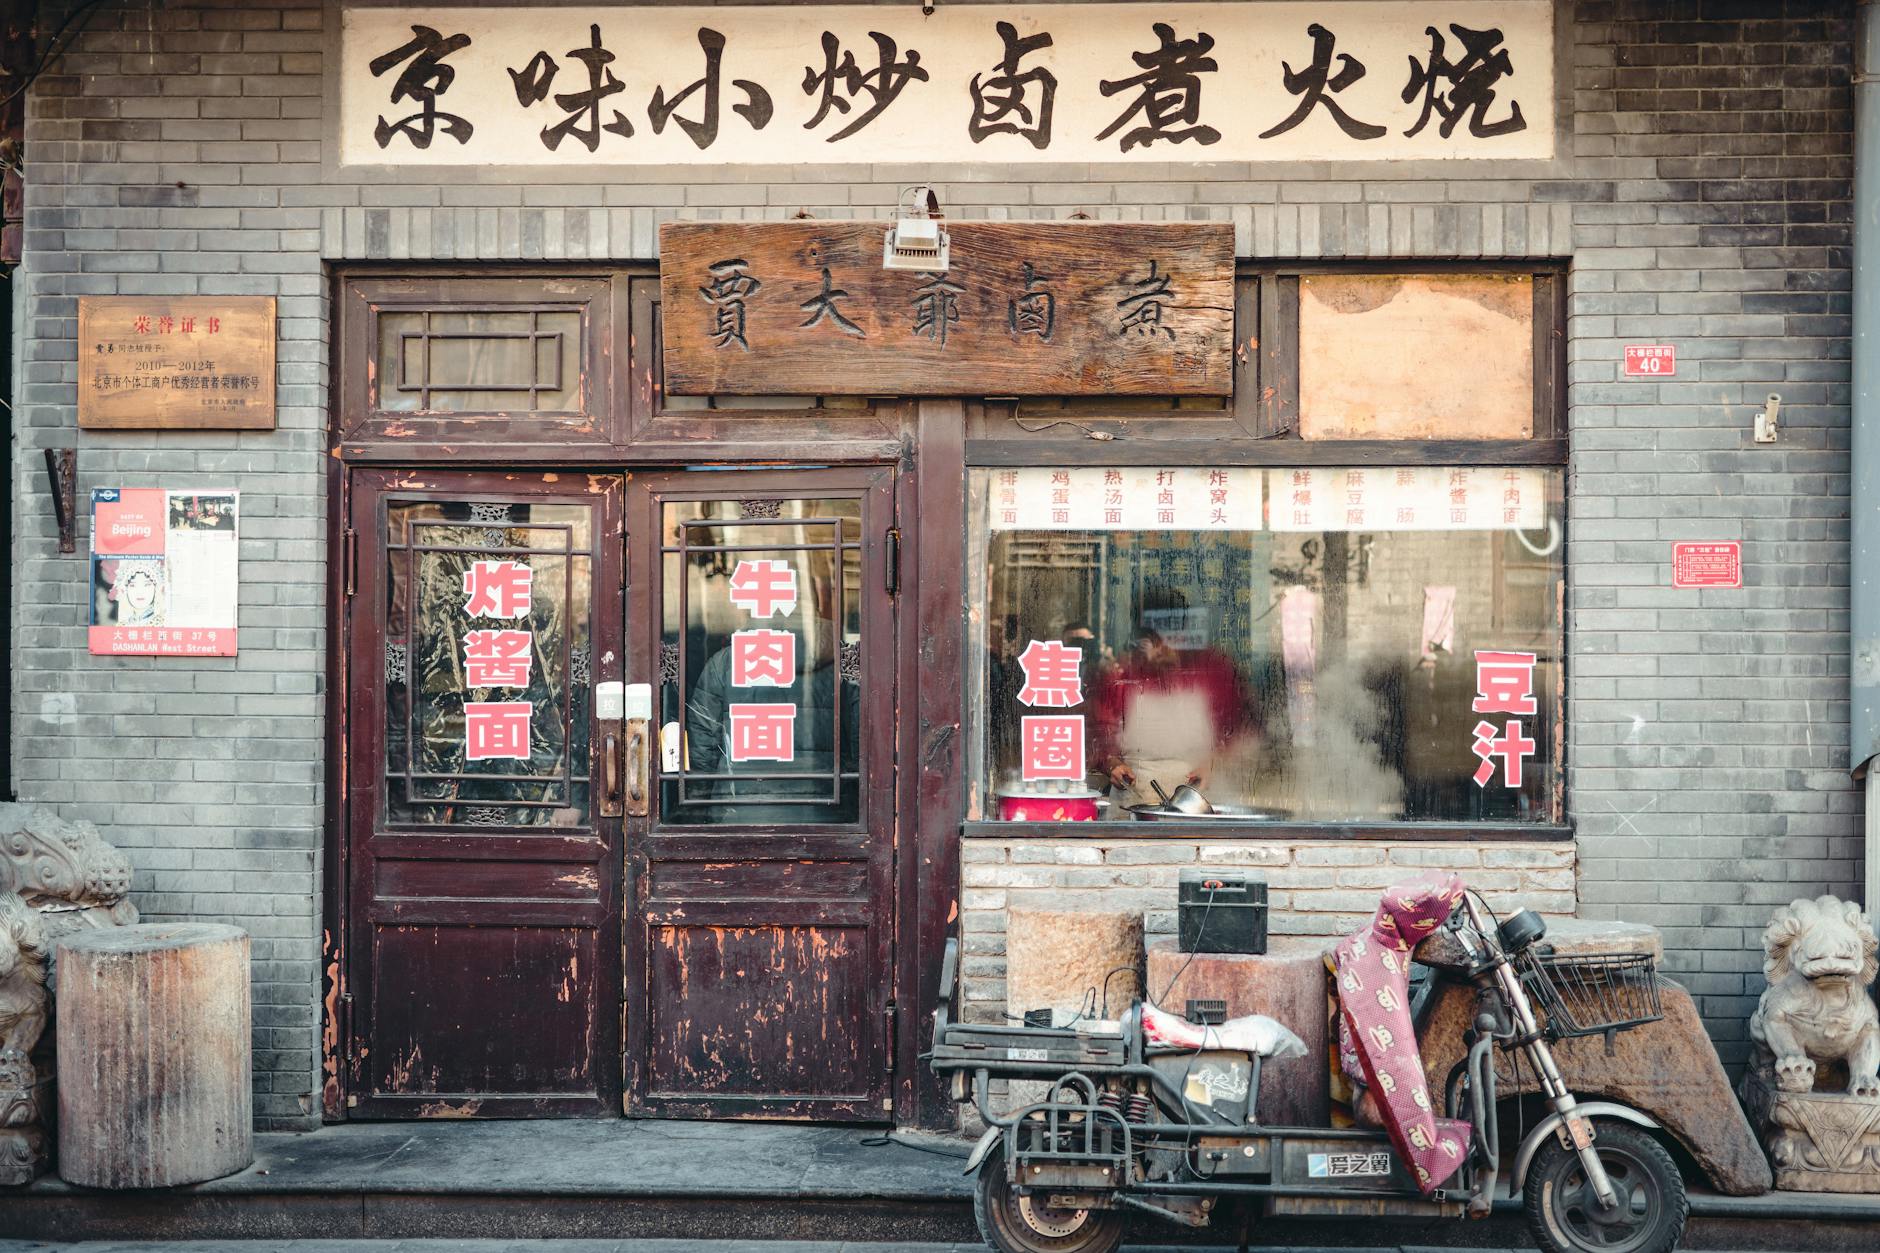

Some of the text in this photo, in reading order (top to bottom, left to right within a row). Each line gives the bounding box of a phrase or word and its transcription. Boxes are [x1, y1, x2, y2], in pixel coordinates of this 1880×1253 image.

[369, 20, 1527, 153] 京味小炒卤煮火烧
[134, 315, 221, 334] 荣誉证书
[1639, 357, 1661, 373] 40
[1051, 471, 1070, 524] 鸡蛋面
[1104, 469, 1123, 524] 热汤面
[1156, 469, 1176, 524] 打卤面
[1209, 469, 1228, 524] 炸窝头
[112, 523, 151, 538] Beijing
[162, 643, 182, 652] West
[186, 643, 216, 653] Street
[463, 560, 533, 761] 炸酱面
[729, 559, 797, 762] 牛肉面
[1016, 639, 1086, 782] 焦圈
[1472, 650, 1538, 788] 豆汁
[1329, 1153, 1390, 1176] 爱之翼
